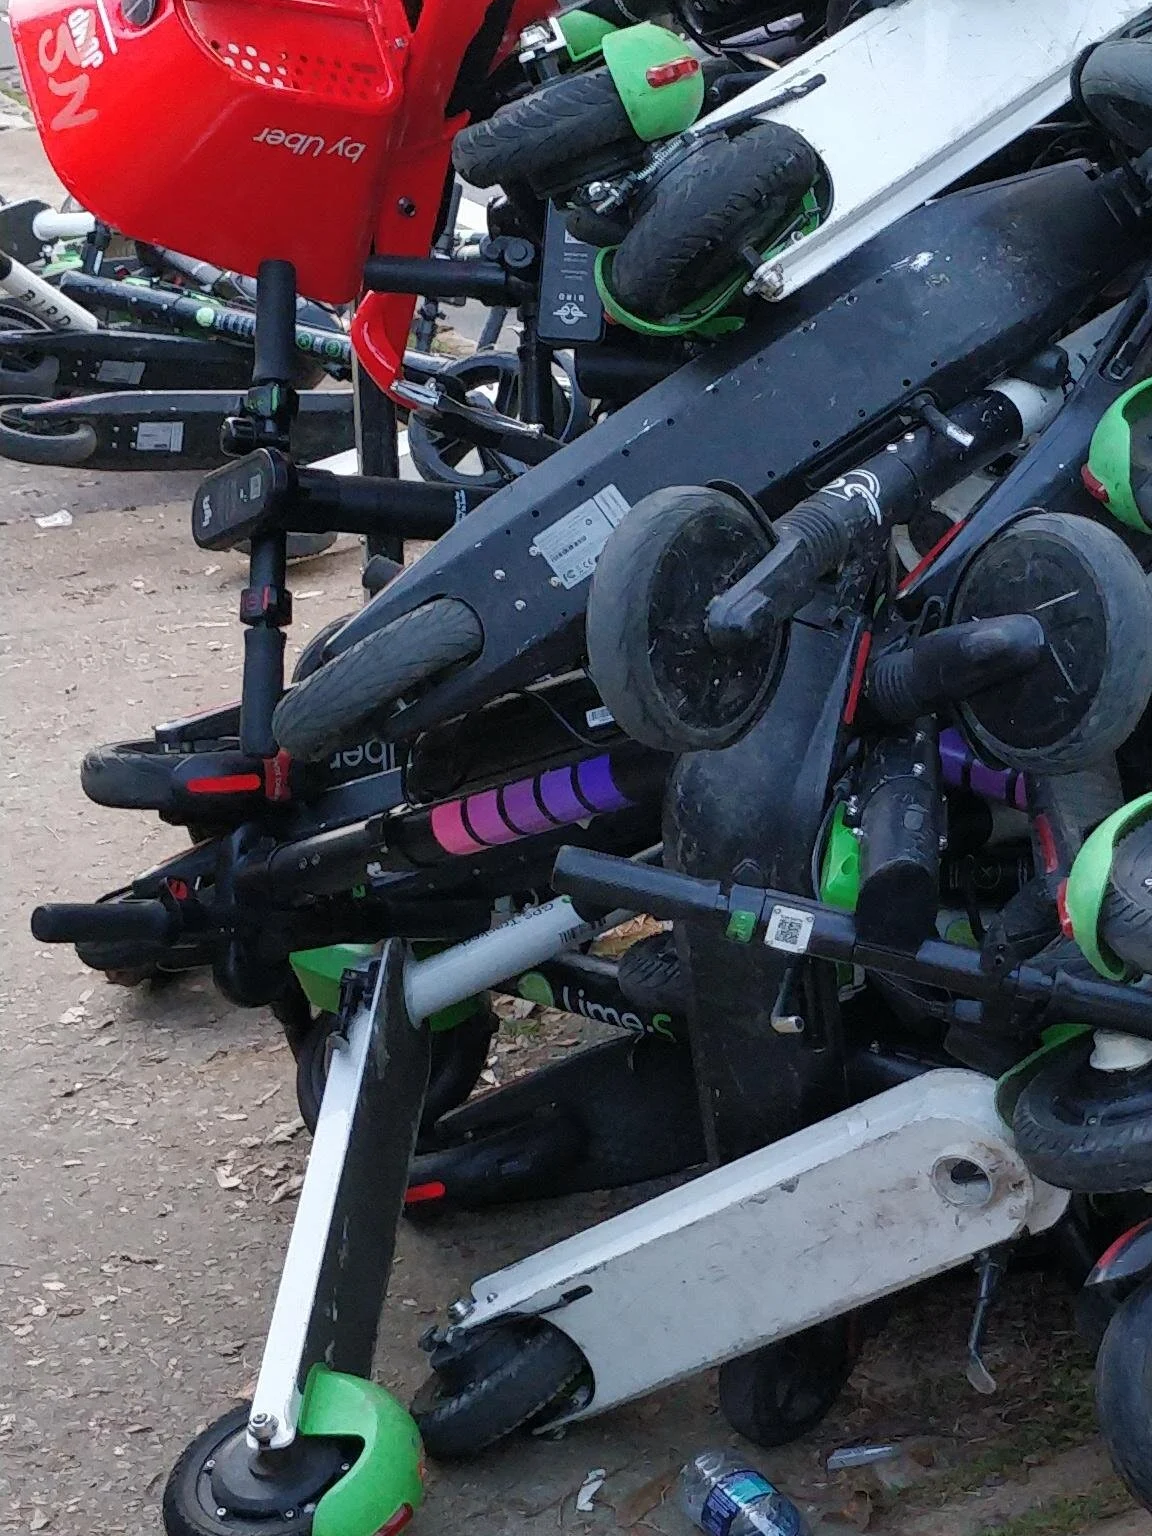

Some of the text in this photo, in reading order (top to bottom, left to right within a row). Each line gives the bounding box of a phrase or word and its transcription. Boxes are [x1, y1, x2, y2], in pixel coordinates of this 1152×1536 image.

[254, 128, 366, 163] by Uber
[19, 289, 72, 327] BIRD
[557, 292, 586, 303] BIRD
